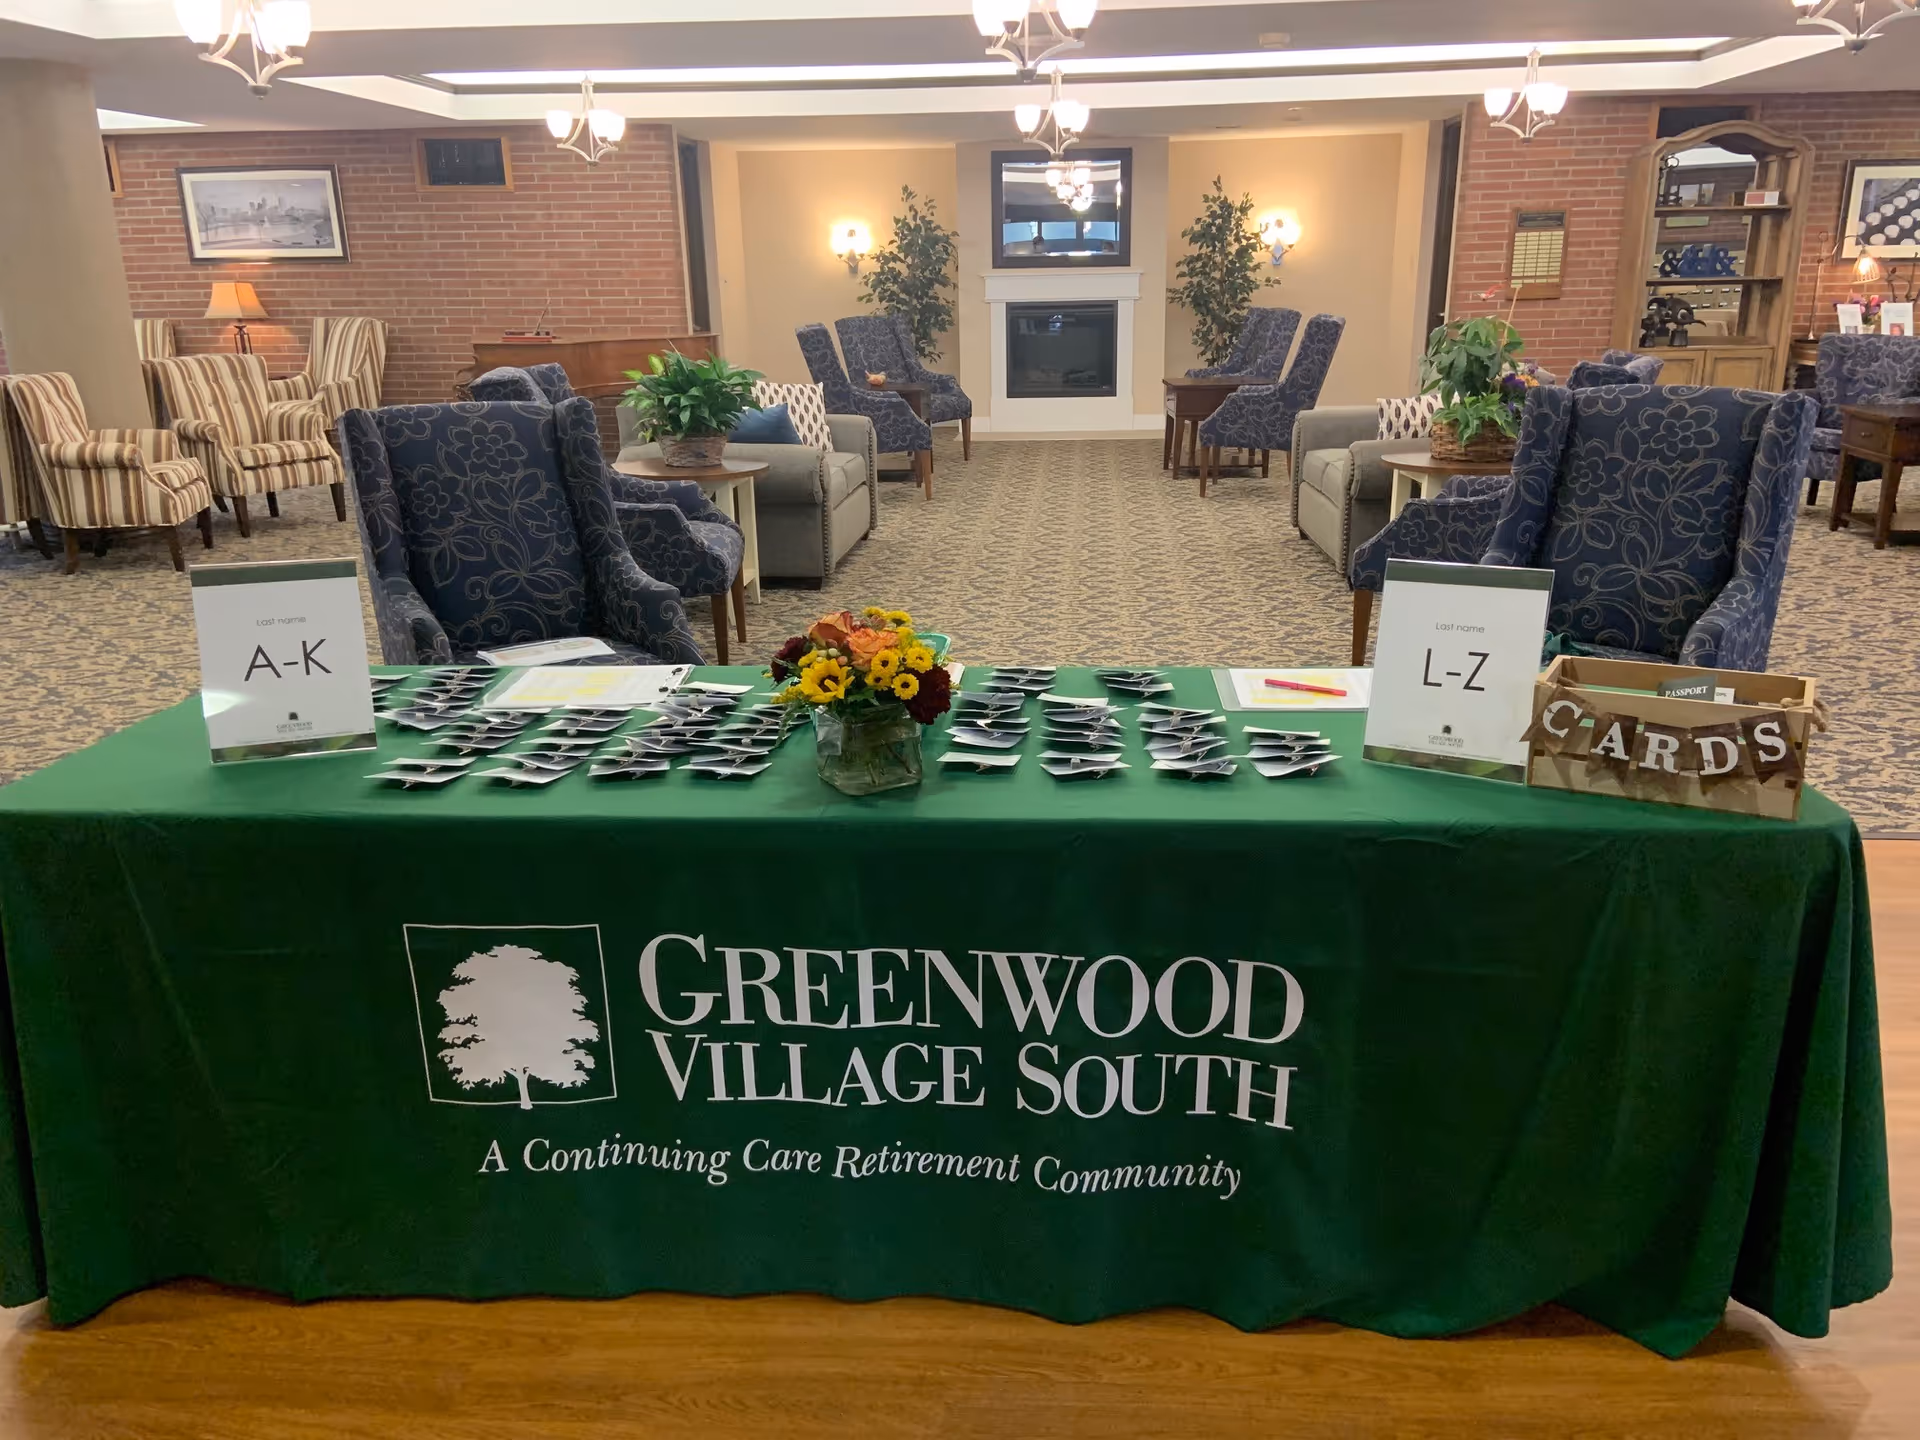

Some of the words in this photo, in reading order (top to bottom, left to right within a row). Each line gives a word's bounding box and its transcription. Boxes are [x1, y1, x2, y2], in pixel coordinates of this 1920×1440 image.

[256, 617, 275, 627] Last
[277, 615, 307, 626] name
[1435, 621, 1455, 632] Last
[1456, 623, 1486, 634] name
[244, 638, 333, 681] A-K
[1422, 647, 1490, 692] L-Z
[1665, 685, 1709, 698] PASSPORT
[1542, 700, 1787, 775] CARDS
[638, 933, 1305, 1044] GREENWOOD
[644, 1029, 986, 1107] VILLAGE
[1016, 1042, 1298, 1130] SOUTH
[478, 1139, 510, 1173] A
[522, 1132, 732, 1186] Continuing
[742, 1138, 822, 1173] Care
[831, 1140, 1021, 1181] Retirement
[1033, 1154, 1242, 1200] Community
